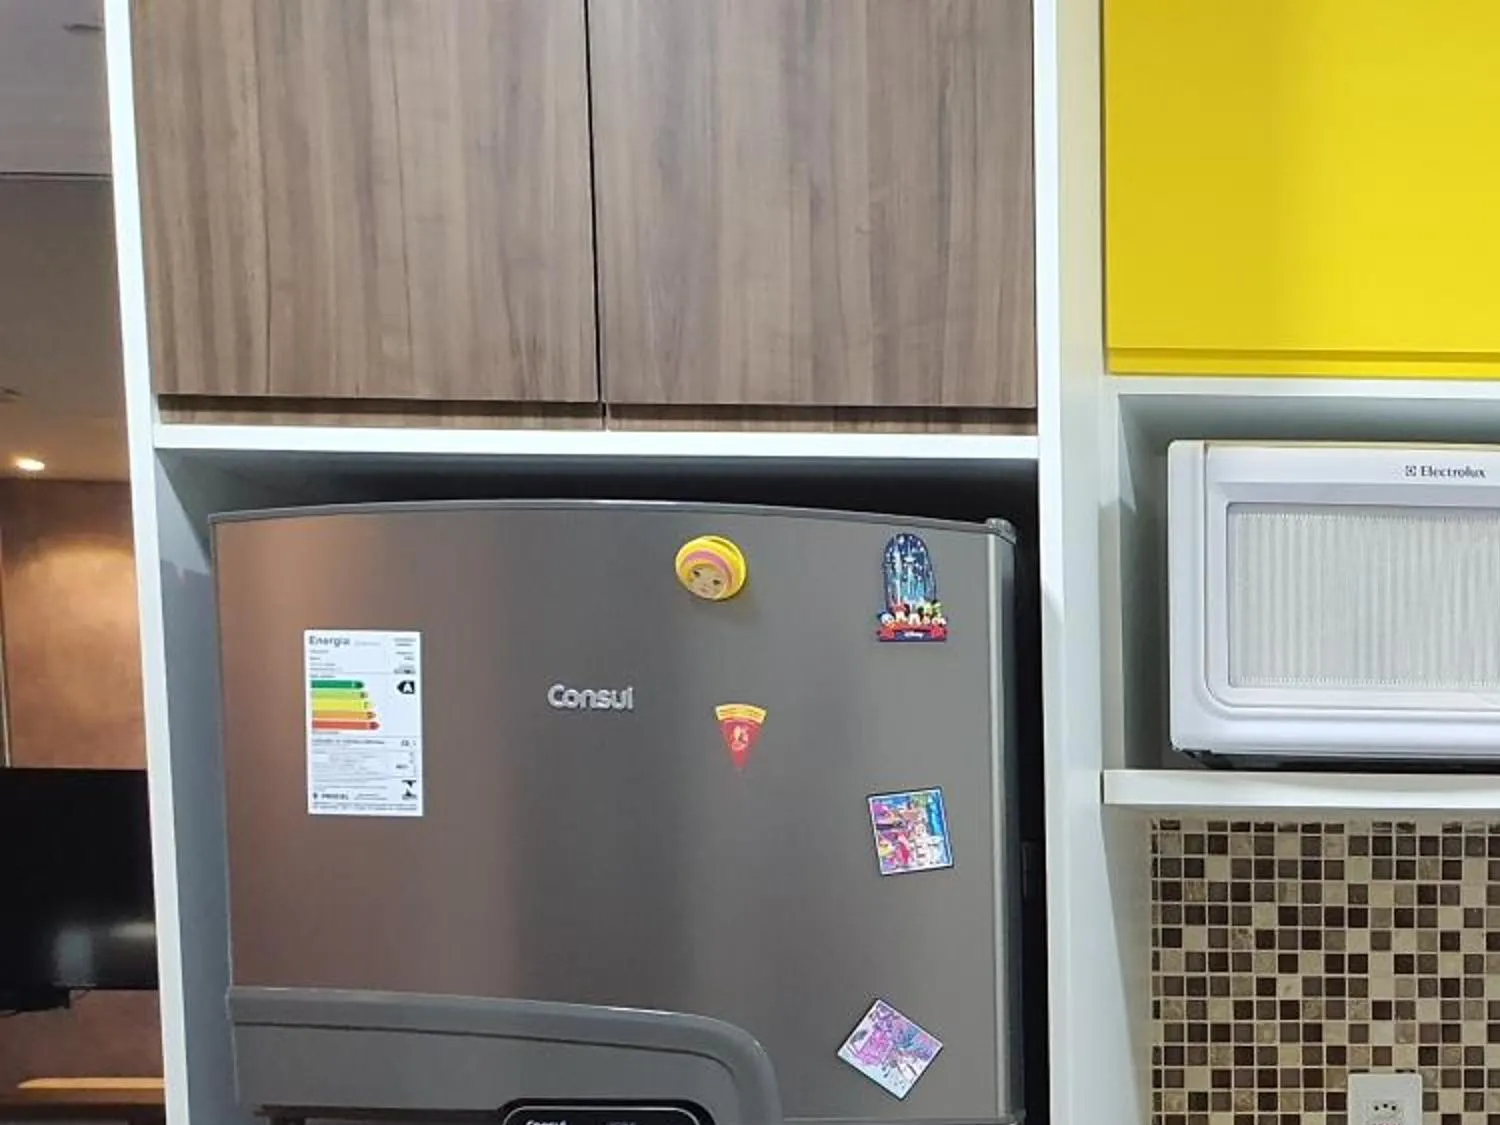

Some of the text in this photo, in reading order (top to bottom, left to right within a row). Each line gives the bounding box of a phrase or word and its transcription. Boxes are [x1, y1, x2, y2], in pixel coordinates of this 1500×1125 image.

[1420, 465, 1486, 478] Electrolux
[309, 636, 350, 647] Energia
[547, 684, 634, 709] Consul
